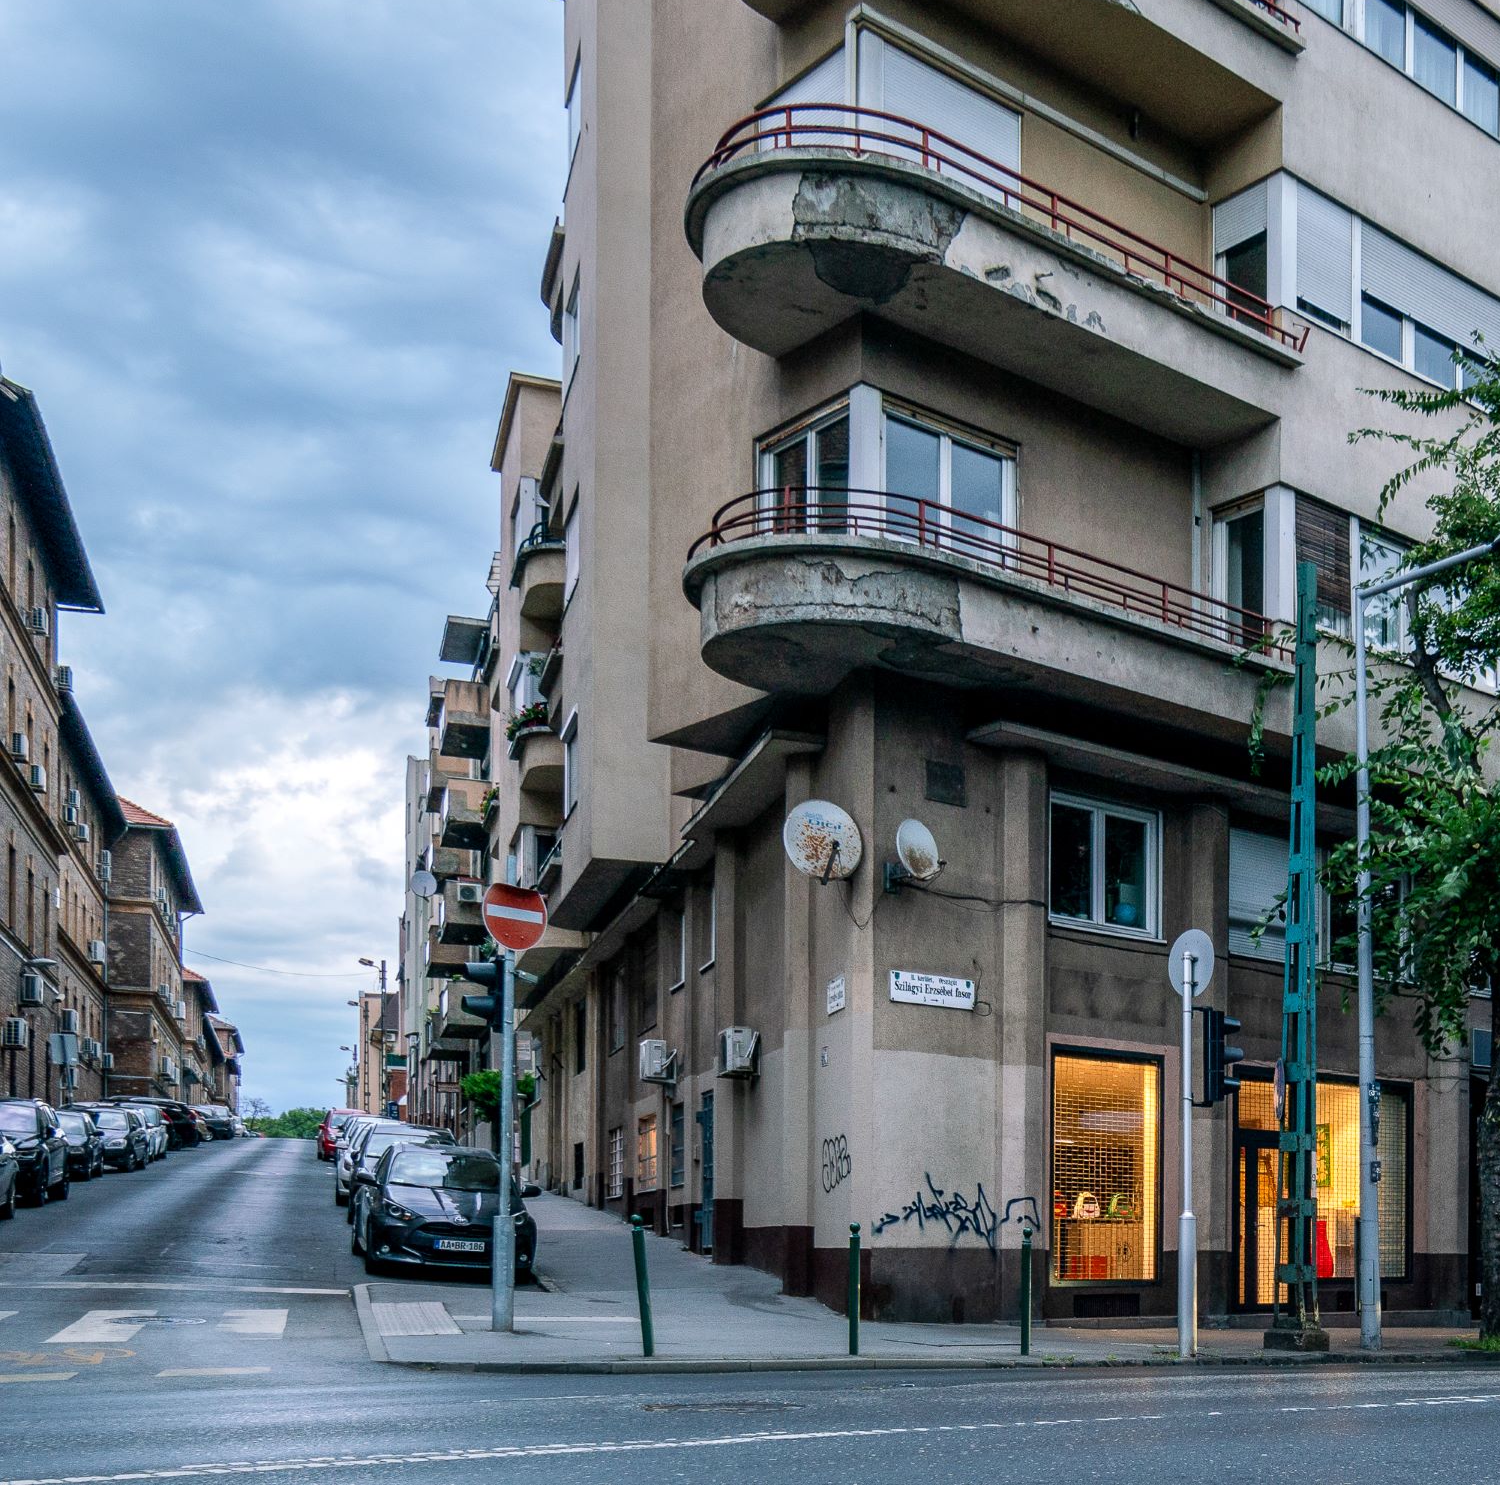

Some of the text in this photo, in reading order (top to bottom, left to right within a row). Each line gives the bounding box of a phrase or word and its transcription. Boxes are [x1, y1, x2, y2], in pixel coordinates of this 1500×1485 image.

[894, 981, 972, 999] Szilágyi Erzsébet fasor
